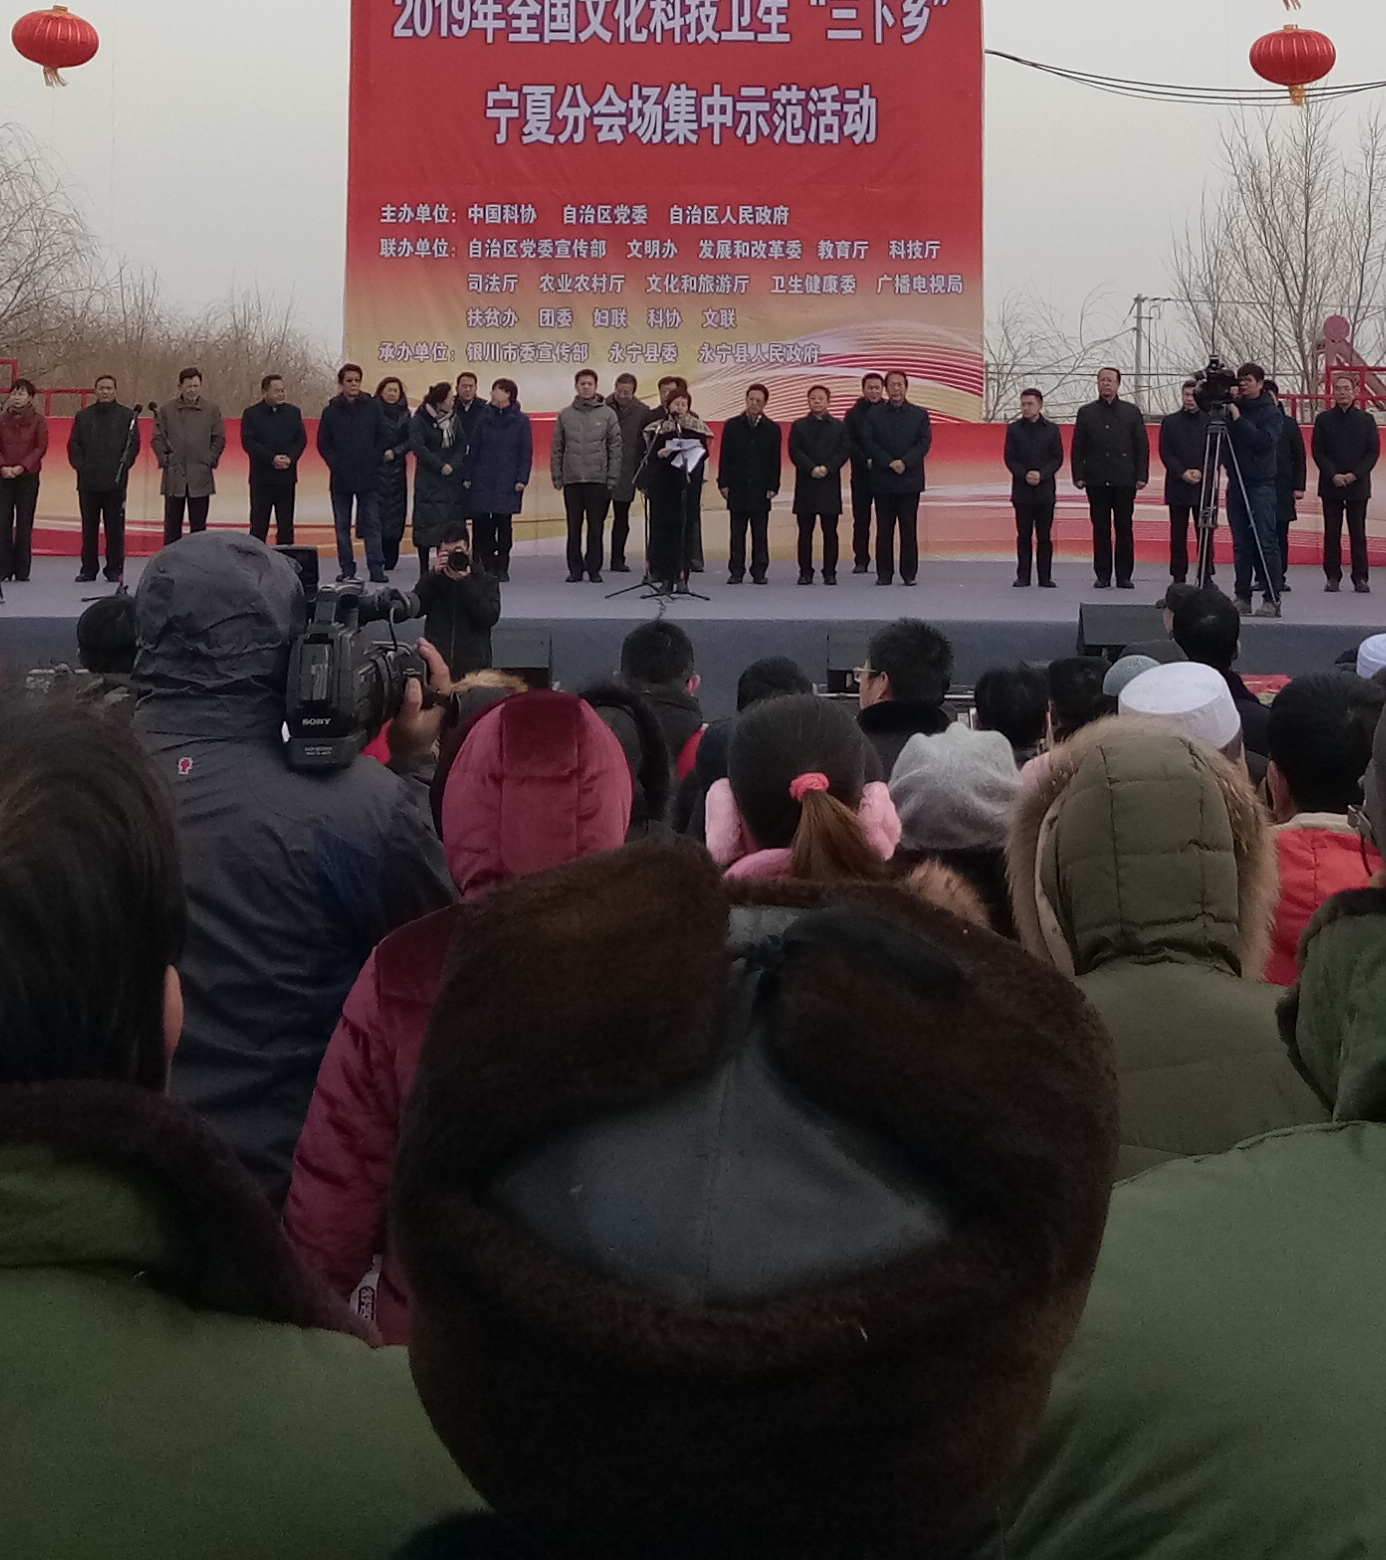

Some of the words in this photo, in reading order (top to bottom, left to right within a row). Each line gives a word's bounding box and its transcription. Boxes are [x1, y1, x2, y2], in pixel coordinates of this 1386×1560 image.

[485, 84, 878, 145] 宁夏分会场集中示范活动
[562, 204, 649, 225] 自治区党委
[669, 205, 790, 226] 自治区人民政府
[626, 239, 678, 259] 文明办
[698, 239, 803, 260] 发展和改革委
[817, 240, 869, 260] 教育厅
[889, 240, 941, 260] 科技厅
[467, 273, 519, 294] 司法厅
[539, 273, 625, 294] 农业农村厅
[646, 274, 750, 295] 文化和旅游厅
[770, 274, 857, 295] 卫生健康委
[875, 275, 963, 295] 广播电视局
[466, 307, 519, 328] 扶贫办
[538, 308, 573, 328] 团委
[592, 308, 628, 328] 妇联
[647, 308, 682, 328] 科协
[702, 308, 737, 329] 文联
[608, 342, 678, 363] 永宁县委
[698, 343, 821, 364] 永宁县人民政府
[302, 717, 332, 726] SONY
